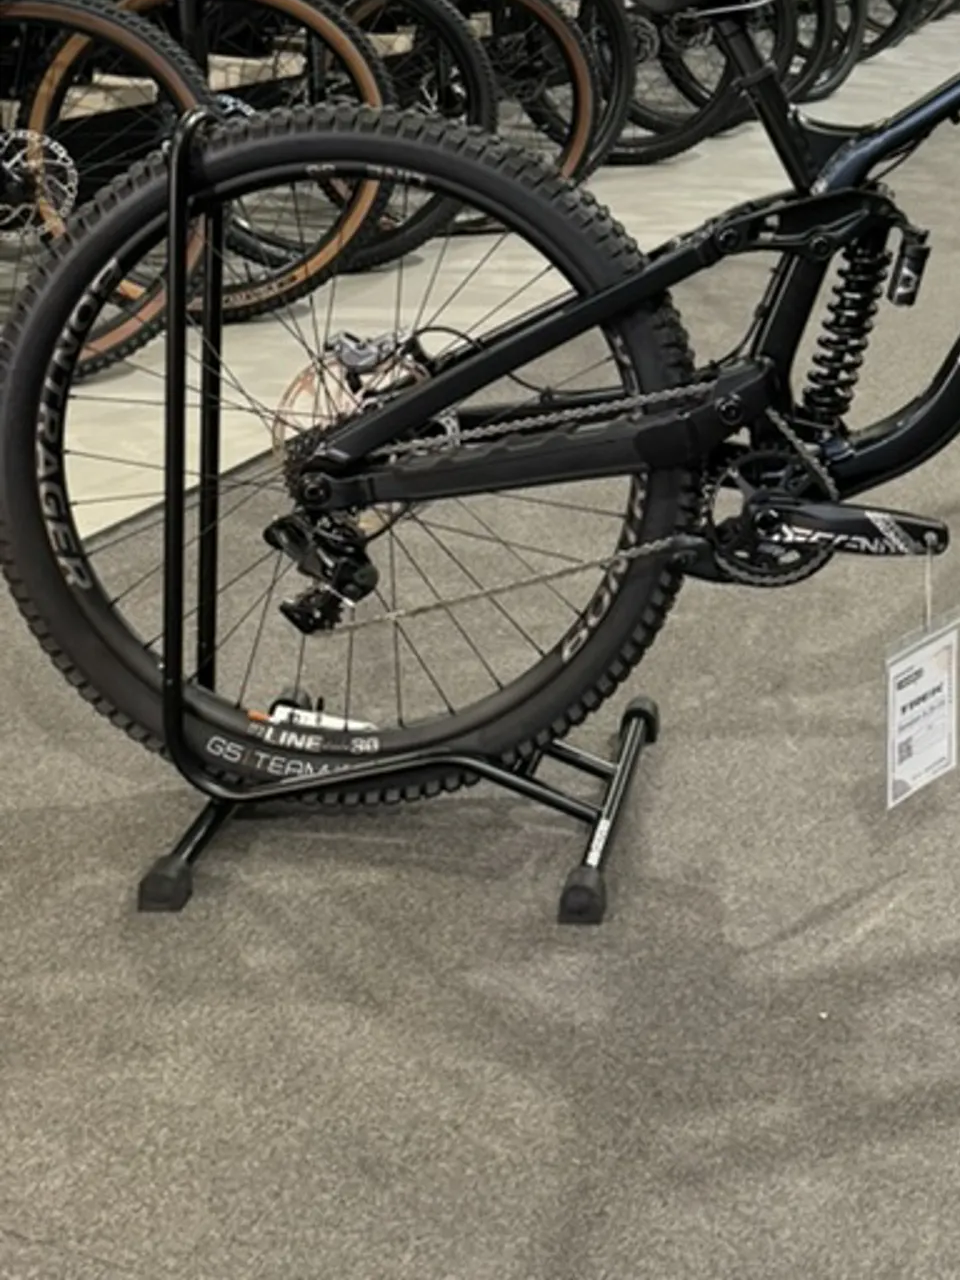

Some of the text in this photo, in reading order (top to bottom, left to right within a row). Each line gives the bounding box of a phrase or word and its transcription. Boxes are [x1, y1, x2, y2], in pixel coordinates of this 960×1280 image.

[36, 255, 121, 592] BONTRAGER
[206, 735, 243, 764] G5
[263, 725, 324, 754] LINE
